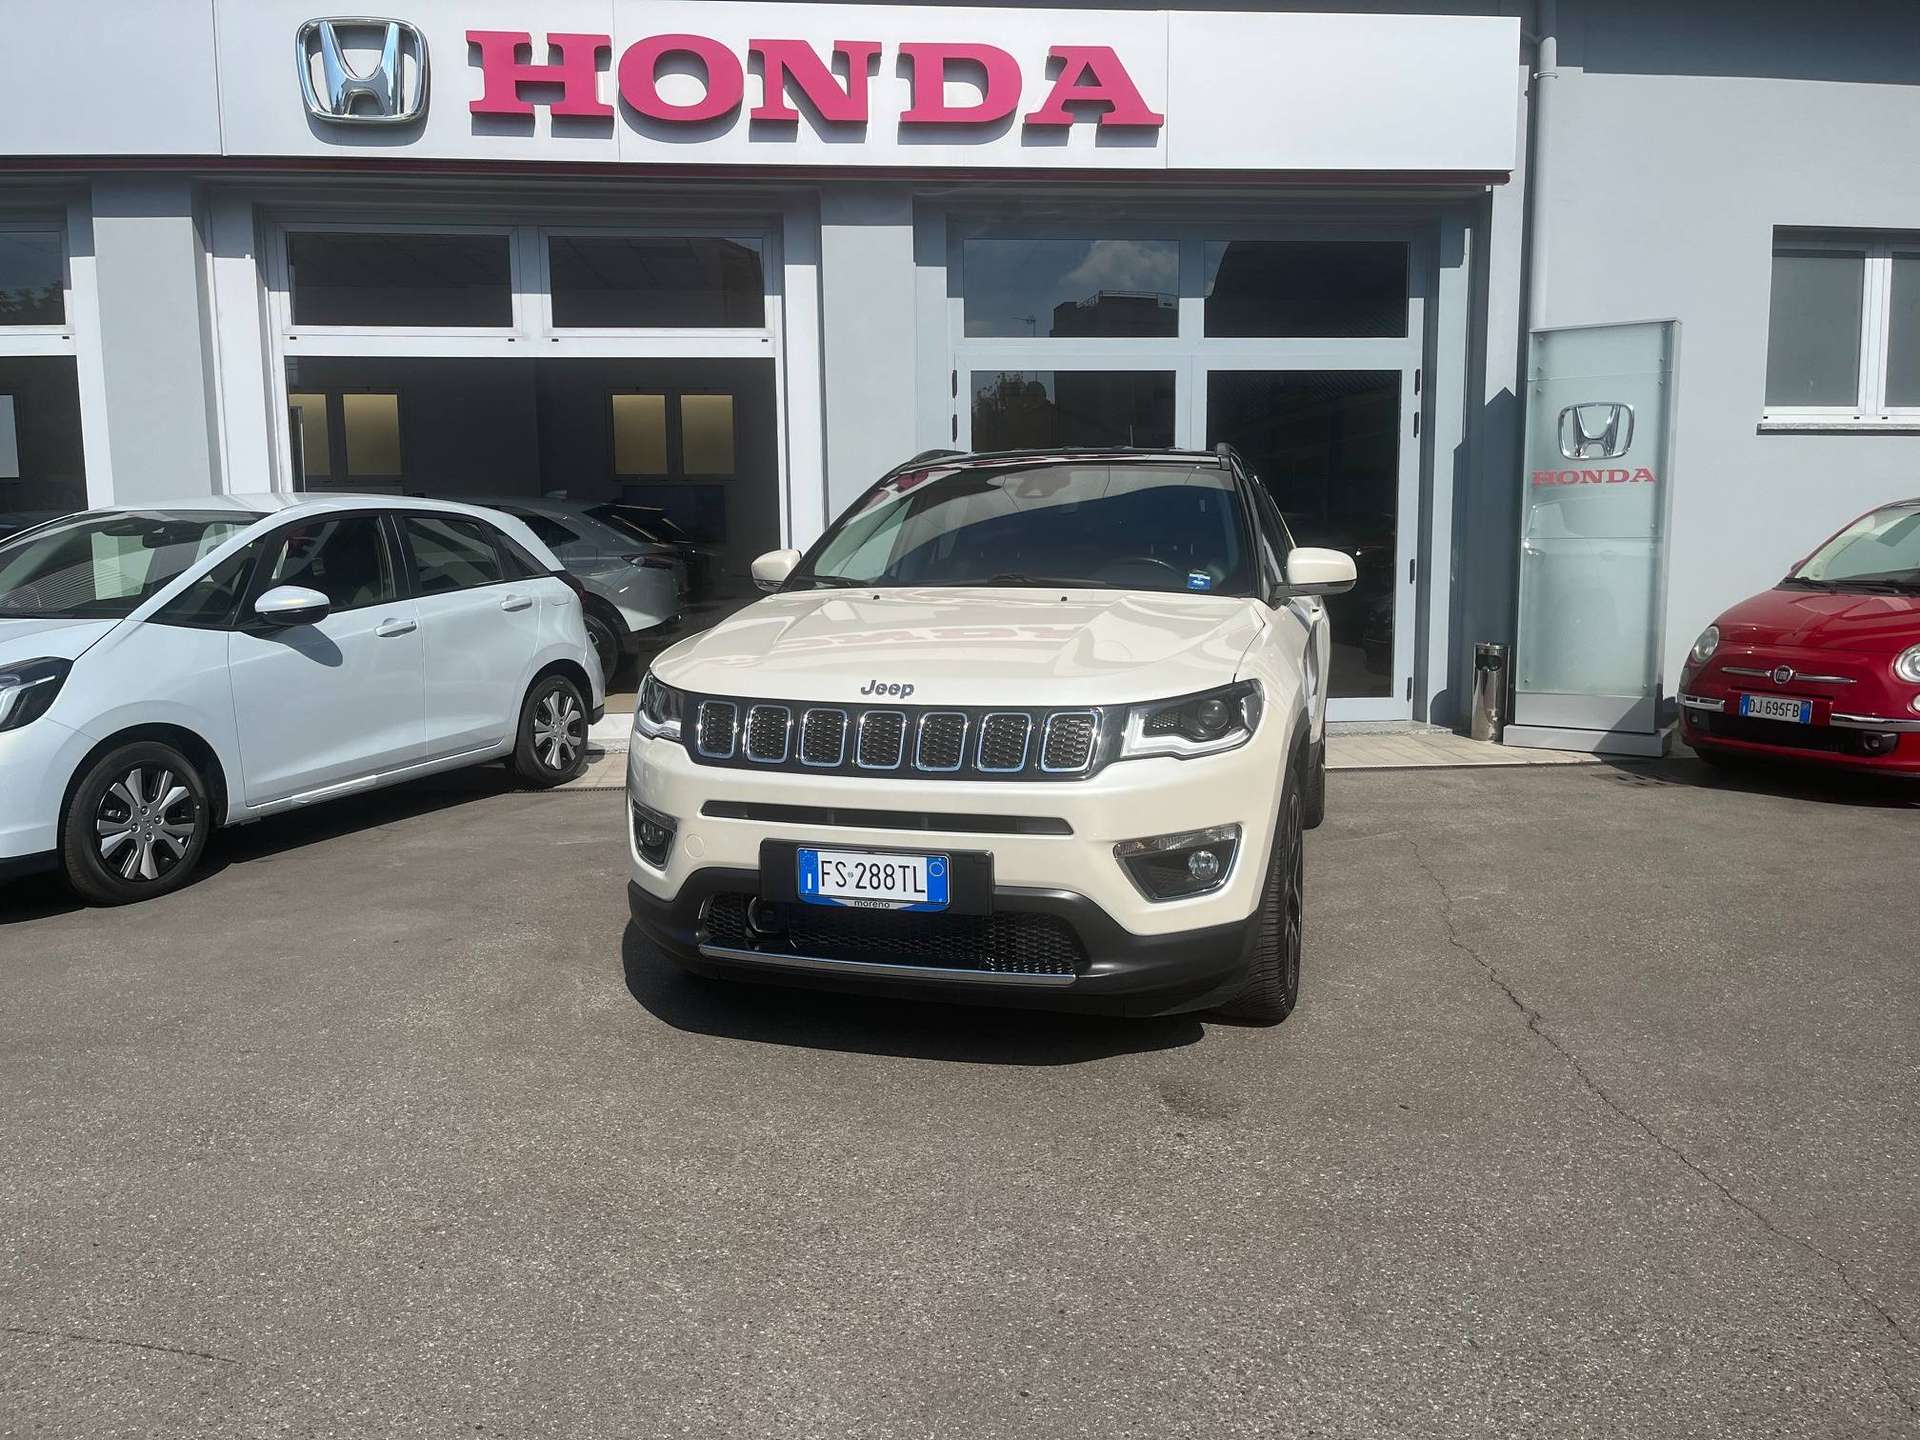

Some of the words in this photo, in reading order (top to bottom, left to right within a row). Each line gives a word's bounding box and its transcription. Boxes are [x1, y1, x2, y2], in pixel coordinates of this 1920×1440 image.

[466, 29, 1164, 127] HONDA
[1532, 468, 1656, 487] HONDA
[861, 679, 914, 698] Jeep
[854, 899, 891, 909] moreno
